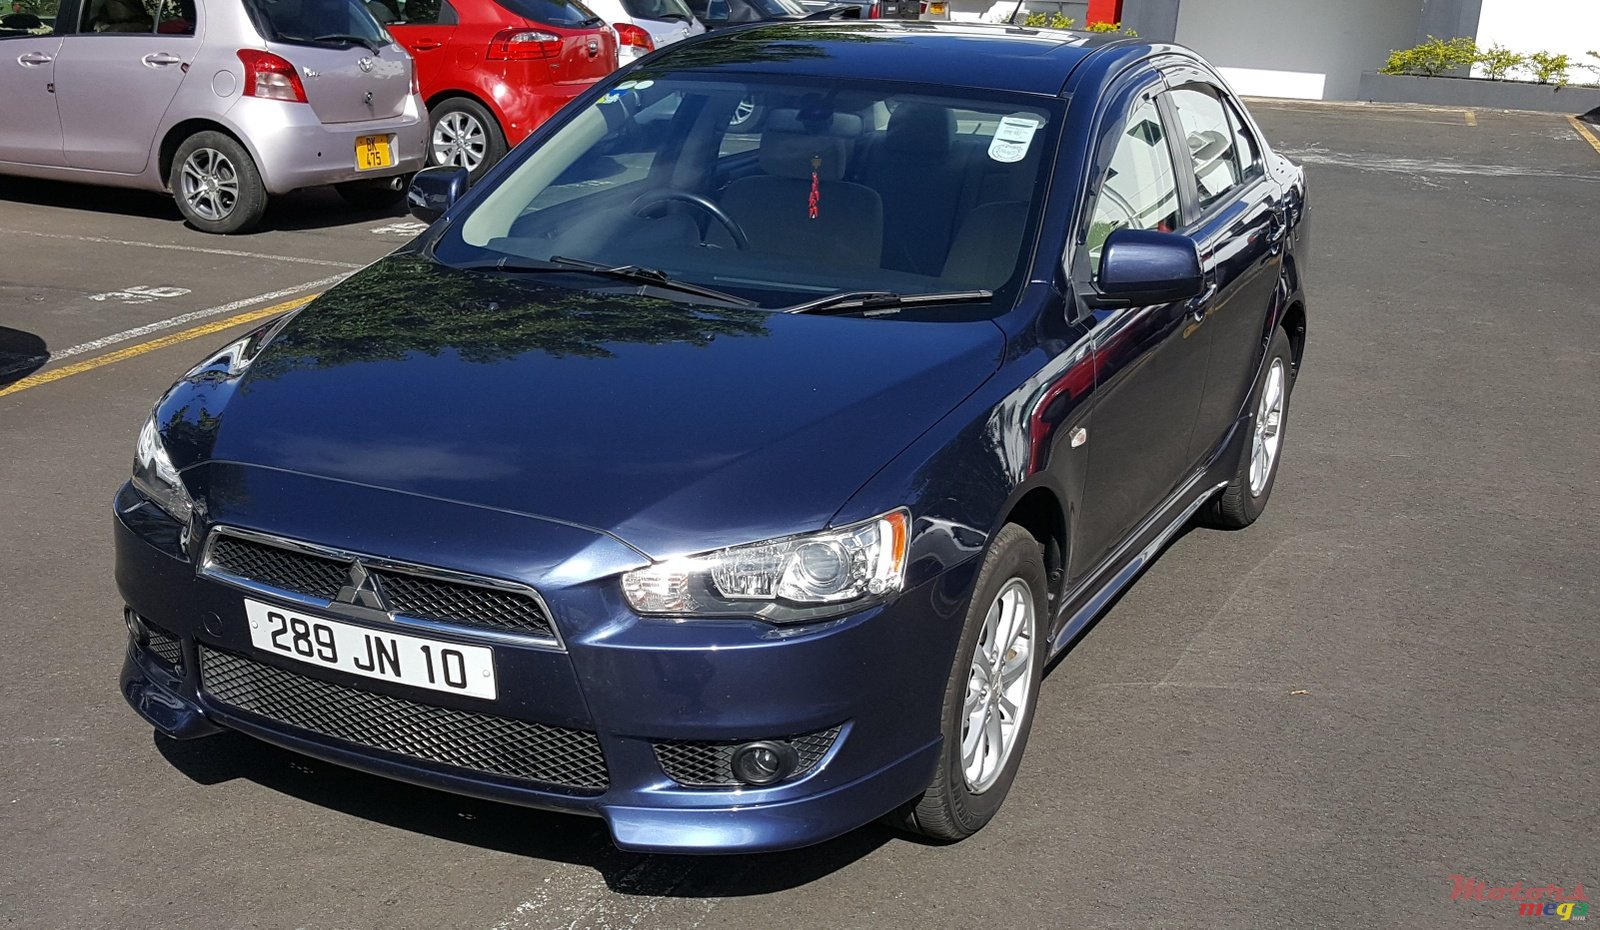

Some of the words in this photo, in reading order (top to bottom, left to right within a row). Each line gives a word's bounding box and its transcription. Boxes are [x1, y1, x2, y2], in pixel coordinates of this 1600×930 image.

[366, 137, 377, 151] BK
[366, 152, 382, 166] 475
[267, 611, 338, 663] 289
[353, 634, 401, 678] JN
[420, 645, 467, 689] 10
